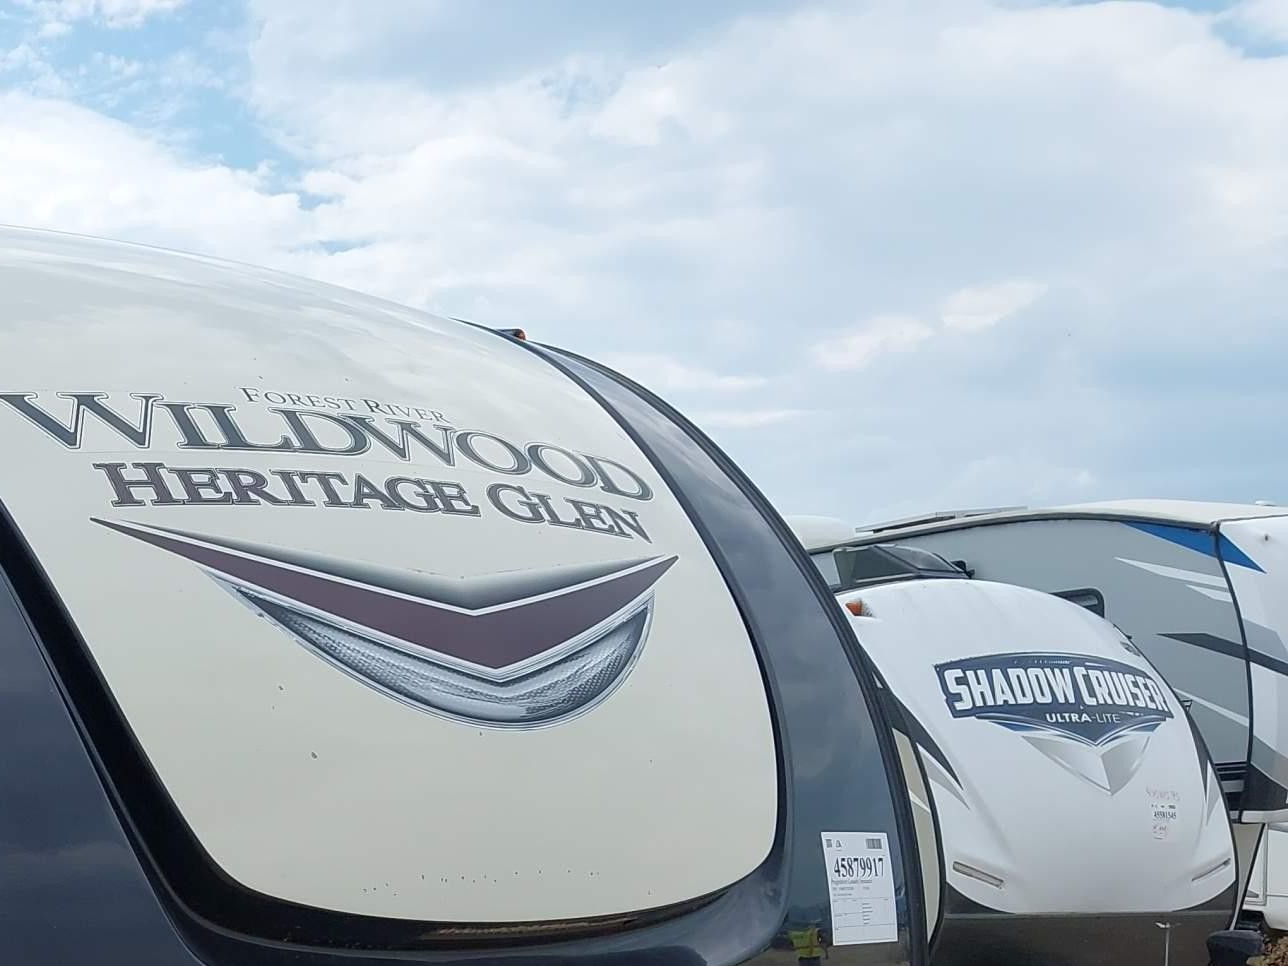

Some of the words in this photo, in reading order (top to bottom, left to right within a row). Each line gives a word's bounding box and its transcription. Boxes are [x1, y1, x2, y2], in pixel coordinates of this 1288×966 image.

[239, 387, 355, 411] FOREST
[360, 398, 451, 424] RIVER
[92, 462, 482, 518] HERITAGE
[486, 482, 653, 544] GLEN
[943, 667, 1075, 711] SHADOW
[1072, 666, 1170, 713] CRUISER
[1045, 712, 1121, 724] ULTRA-LITE
[833, 857, 884, 878] 45879917
